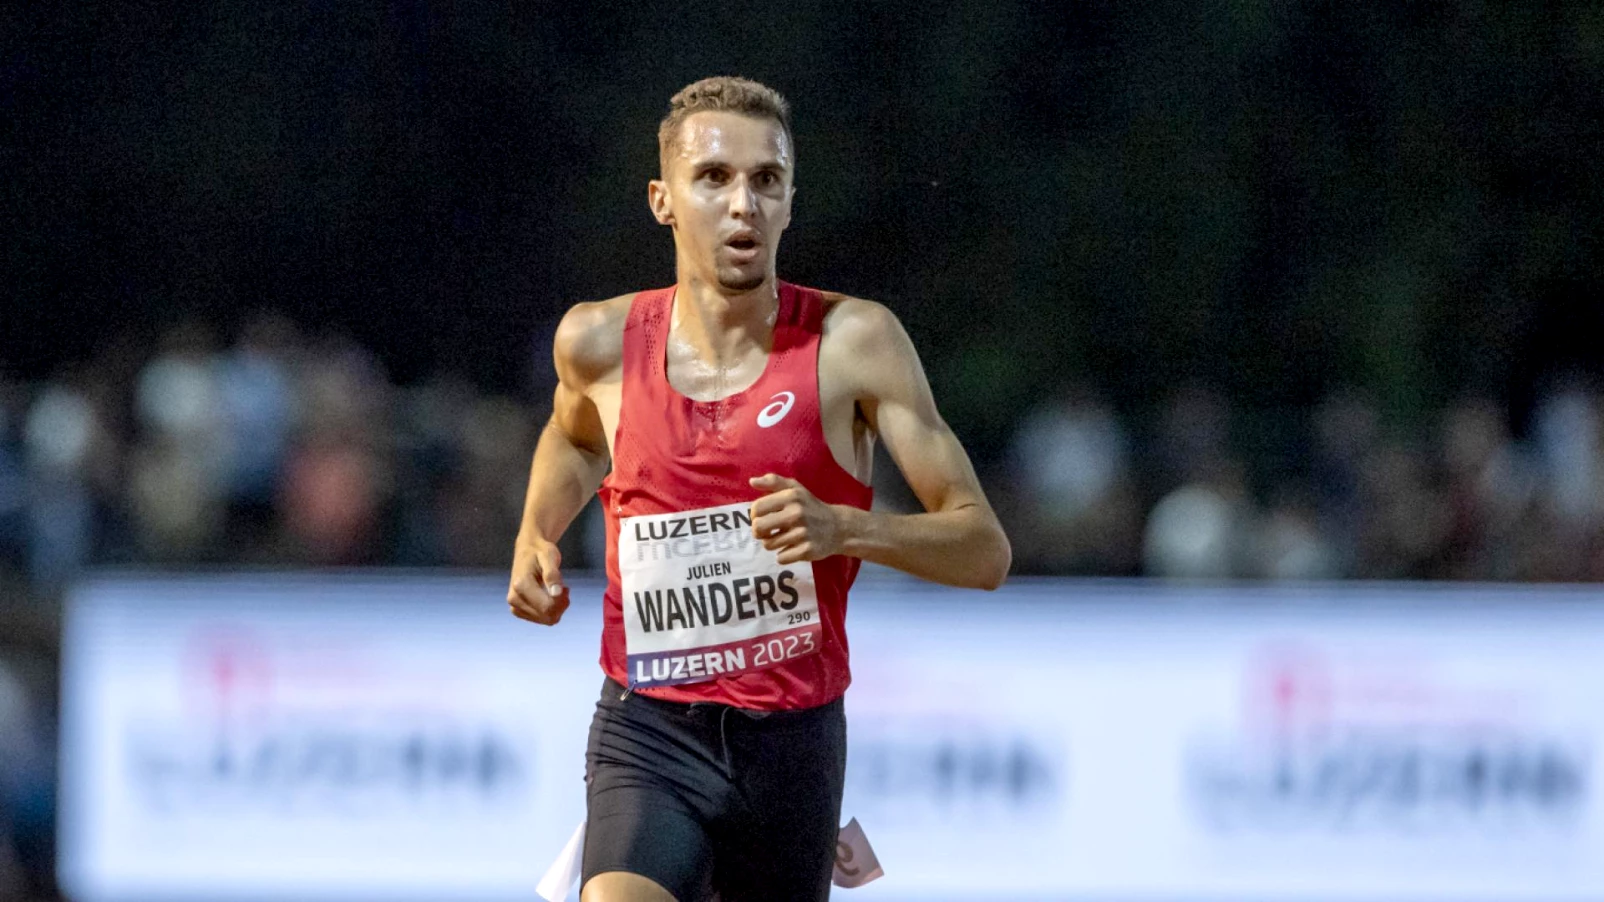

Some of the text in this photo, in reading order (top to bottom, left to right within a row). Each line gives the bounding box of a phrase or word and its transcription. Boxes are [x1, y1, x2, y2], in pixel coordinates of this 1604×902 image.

[635, 508, 752, 541] LUZERN
[686, 561, 731, 580] JULIEN
[634, 570, 799, 633] WANDERS
[787, 611, 811, 625] 290
[636, 632, 815, 683] LUZERN 2023
